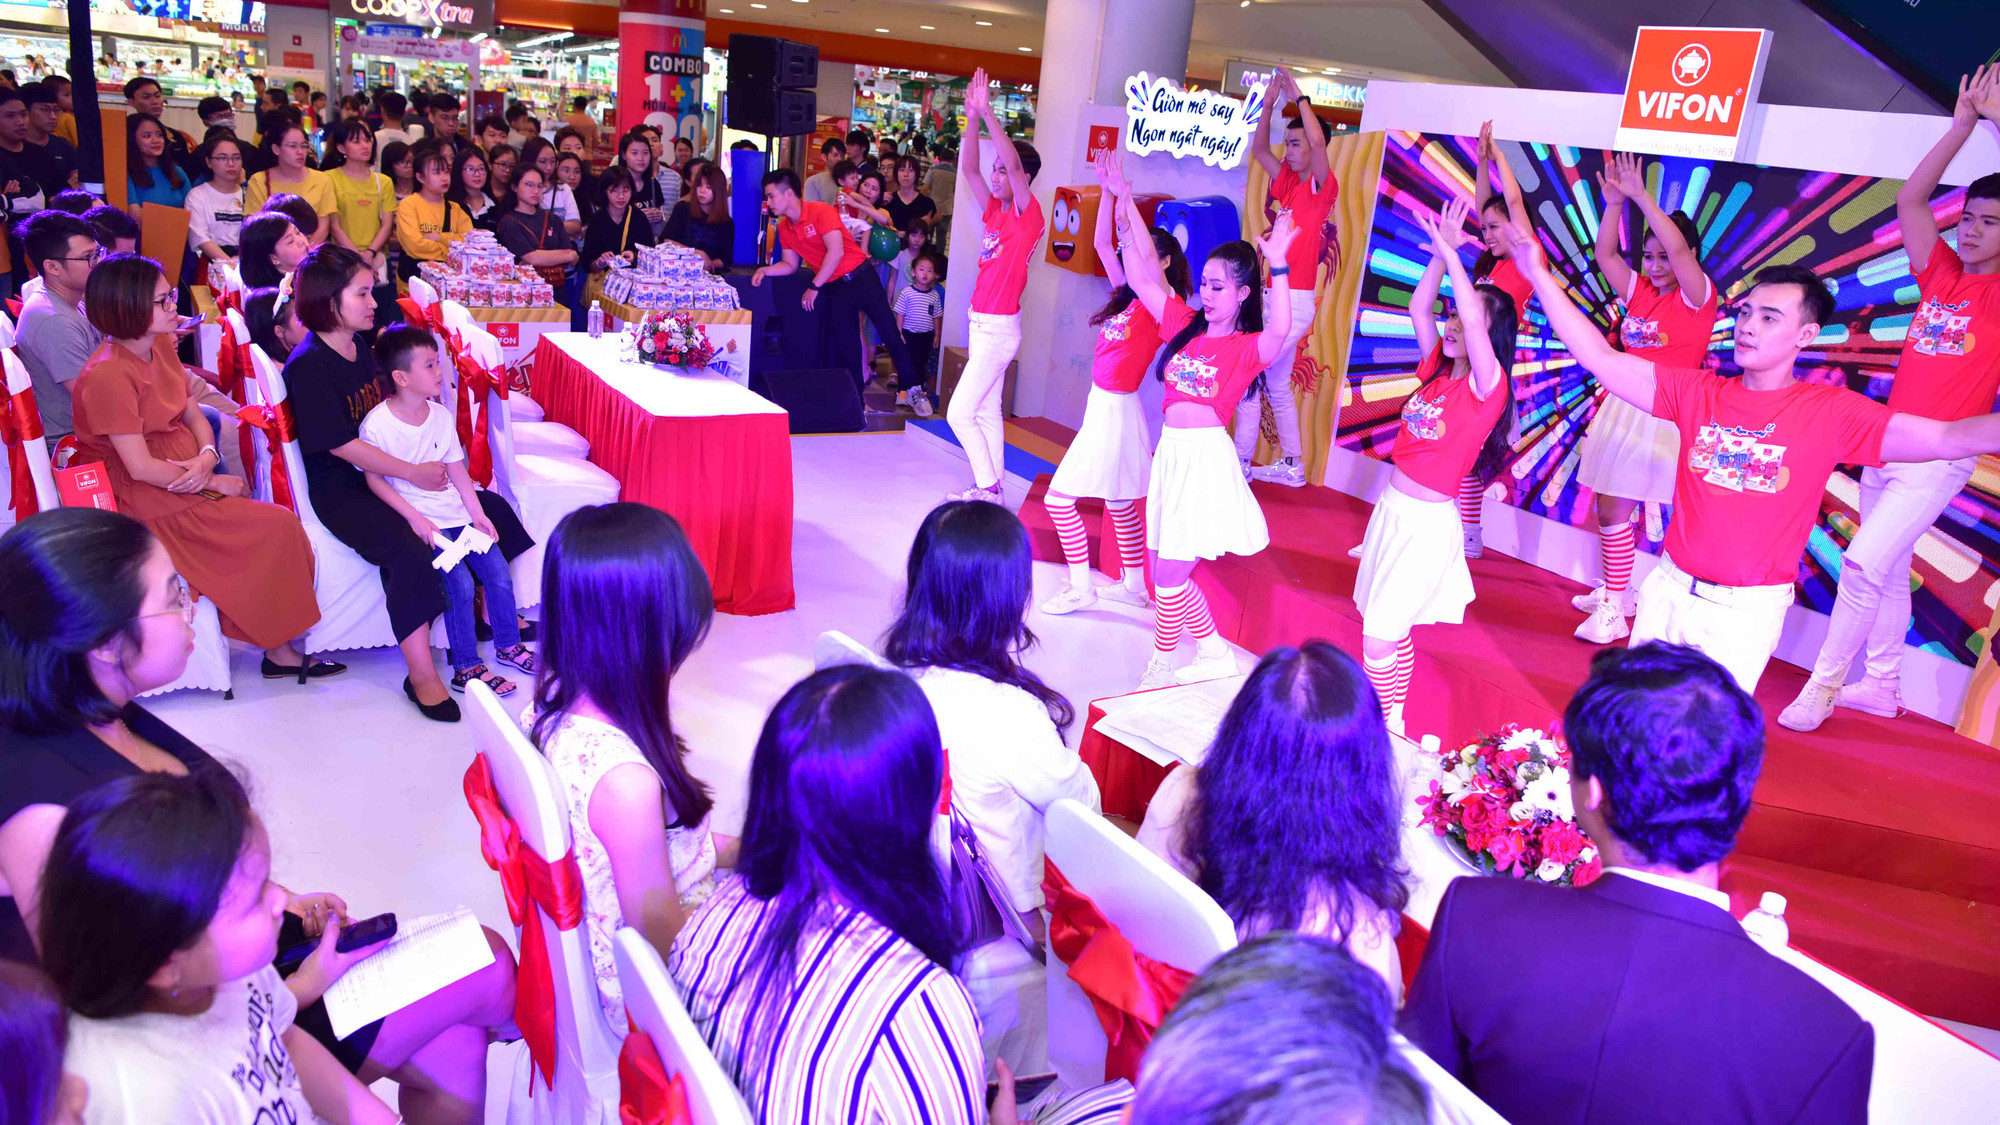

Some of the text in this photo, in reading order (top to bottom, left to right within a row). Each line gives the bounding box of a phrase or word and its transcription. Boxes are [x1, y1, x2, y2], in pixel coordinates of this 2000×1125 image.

[649, 55, 702, 74] COMBO
[644, 73, 662, 101] 1
[643, 98, 666, 112] MÓN
[1152, 86, 1236, 126] Giòn mê say
[1637, 90, 1734, 123] VIFON
[1131, 117, 1242, 161] Ngon ngất ngây!
